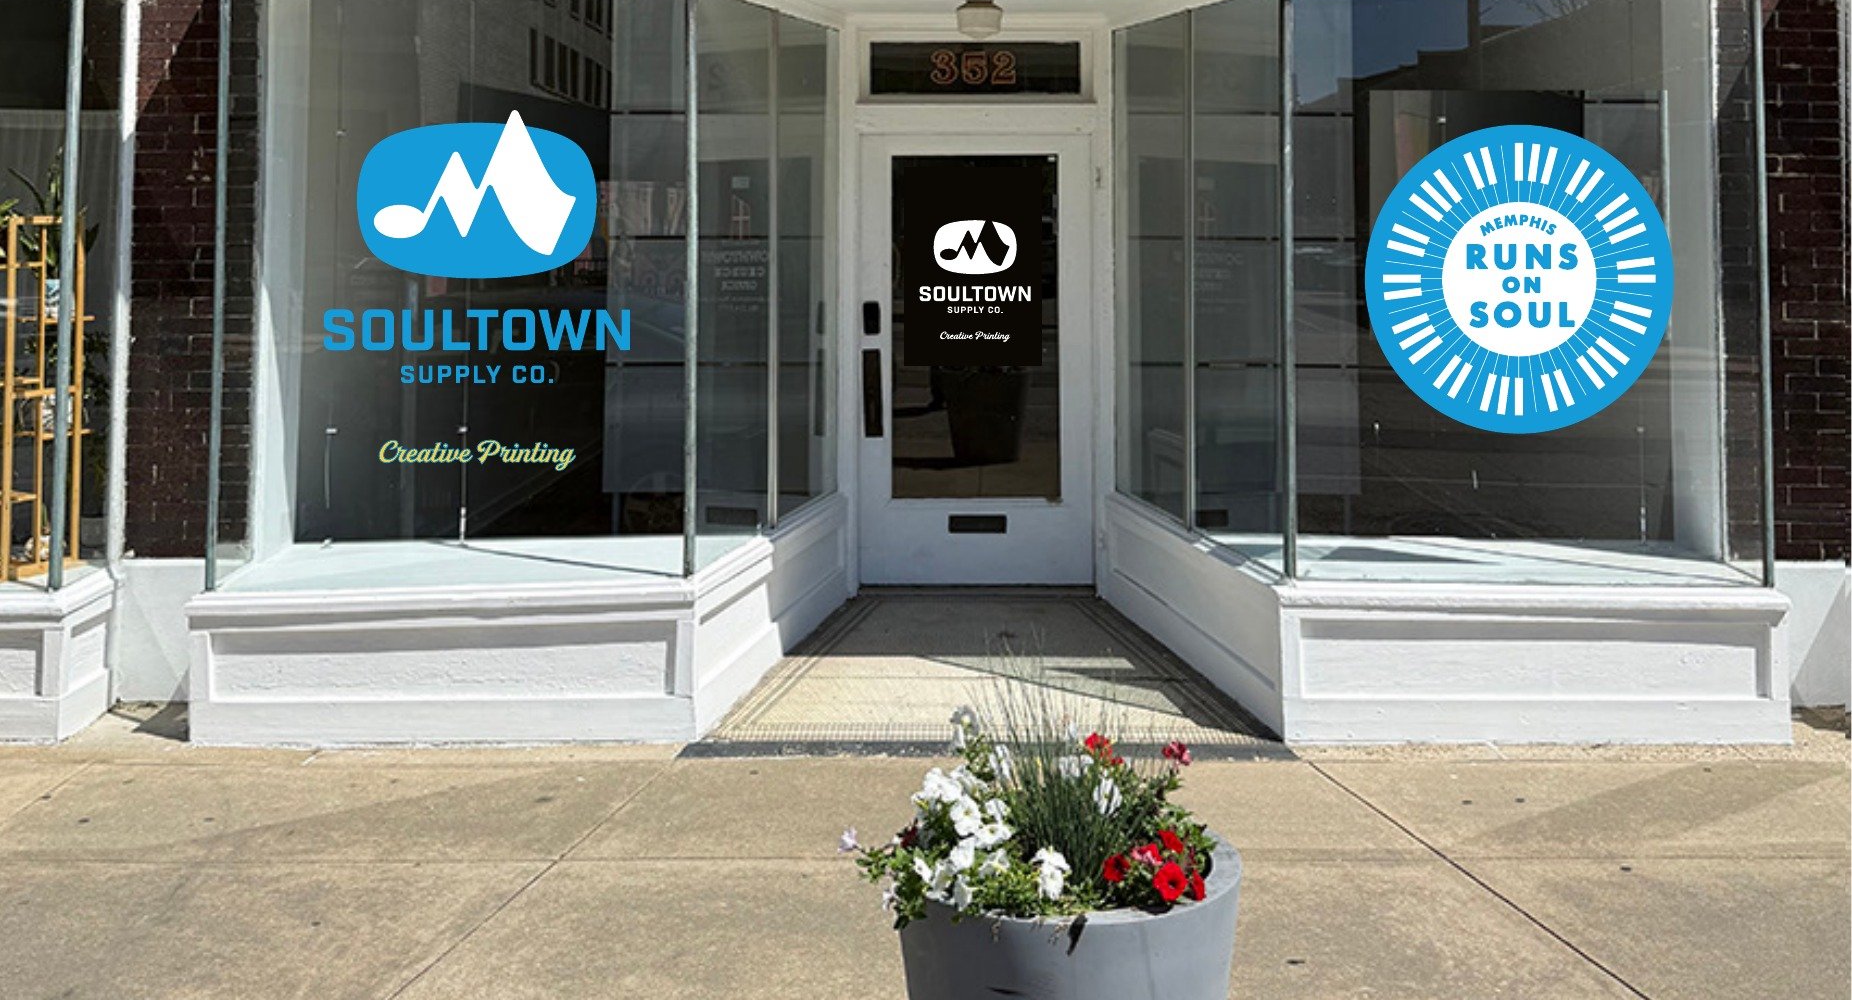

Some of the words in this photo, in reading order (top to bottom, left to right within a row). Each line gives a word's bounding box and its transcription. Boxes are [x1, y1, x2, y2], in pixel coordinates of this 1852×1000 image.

[930, 51, 1016, 85] 352
[1478, 213, 1557, 237] MEMPHIS
[1466, 243, 1579, 271] RUNS
[918, 285, 1032, 302] SOULTOWN
[1501, 276, 1541, 294] ON
[947, 306, 984, 314] SUPPLY
[987, 306, 1004, 314] CO.
[1469, 301, 1576, 329] SOUL
[323, 308, 632, 351] SOULTOWN
[939, 330, 974, 341] Creative
[974, 330, 1011, 343] Printing
[400, 365, 501, 384] SUPPLY
[511, 365, 554, 384] CO.
[378, 440, 474, 465] Creative
[475, 439, 577, 471] Printing
